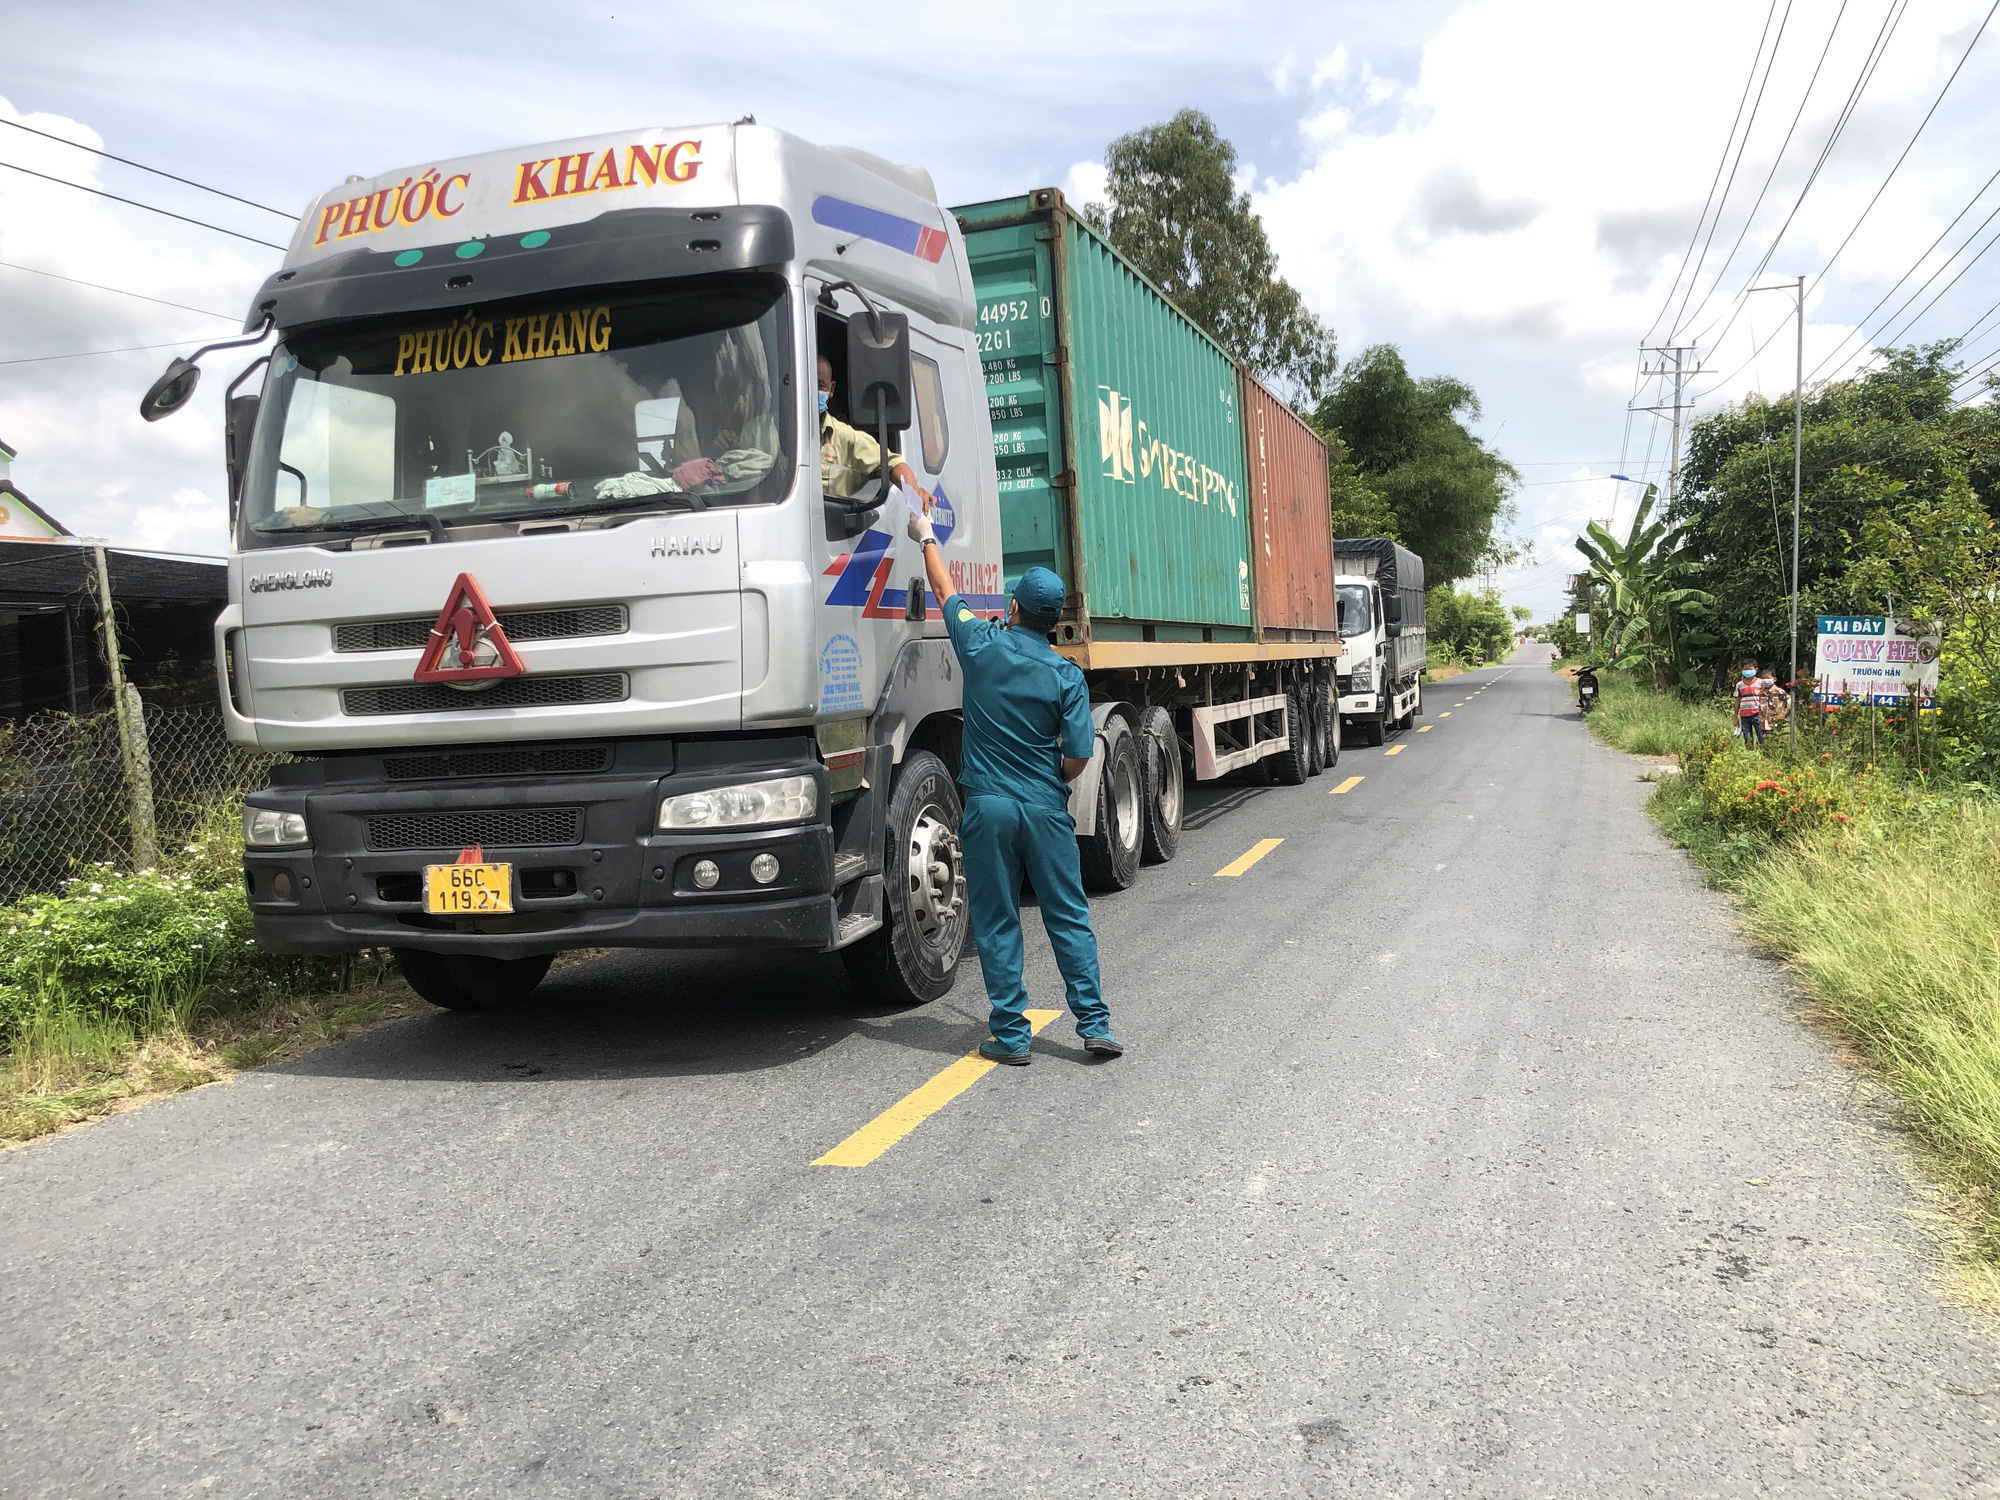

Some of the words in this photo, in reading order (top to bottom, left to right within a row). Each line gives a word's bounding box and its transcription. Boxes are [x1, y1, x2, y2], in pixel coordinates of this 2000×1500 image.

[311, 167, 472, 249] PHƯỚC
[508, 139, 704, 207] KHANG
[975, 300, 1028, 327] 44952
[394, 309, 494, 377] PHƯỚC
[501, 306, 612, 363] KHANG
[975, 329, 1011, 353] 22G1
[1006, 358, 1016, 370] KG
[1008, 371, 1021, 382] LBS
[1008, 394, 1018, 405] KG
[1010, 407, 1023, 418] LBS
[1013, 431, 1022, 441] KG
[1013, 442, 1026, 454] LBS
[650, 533, 722, 558] HAIAU
[249, 567, 333, 593] CHENGLONG
[1825, 620, 1848, 634] TẠI
[1852, 618, 1882, 632] ĐÂY
[1822, 639, 1884, 662] QUAY
[1886, 640, 1936, 664] HEO
[451, 868, 485, 887] 66C
[440, 890, 500, 910] 119.27
